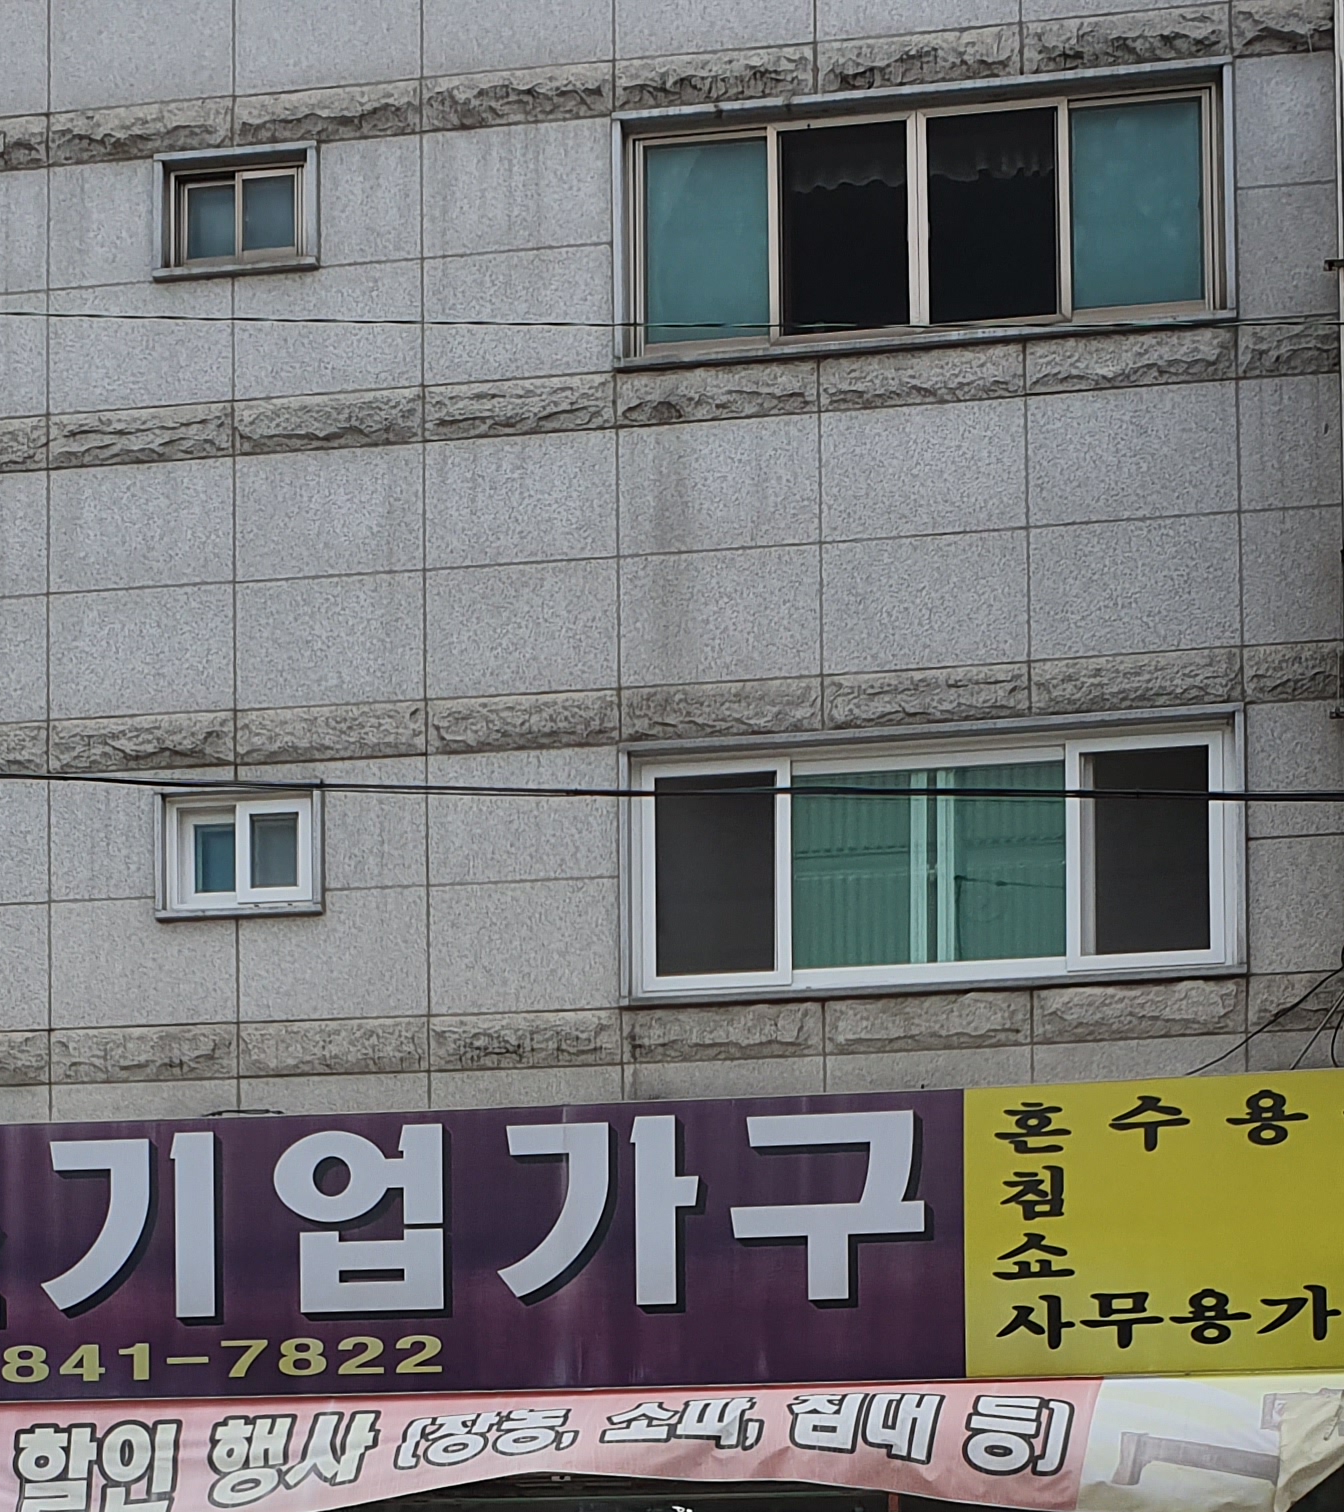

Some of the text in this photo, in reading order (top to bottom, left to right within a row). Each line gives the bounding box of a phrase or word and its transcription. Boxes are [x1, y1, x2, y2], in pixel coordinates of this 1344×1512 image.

[1, 1334, 444, 1384] 841-7822
[208, 1410, 381, 1508] 행사
[788, 1392, 944, 1464] 침대
